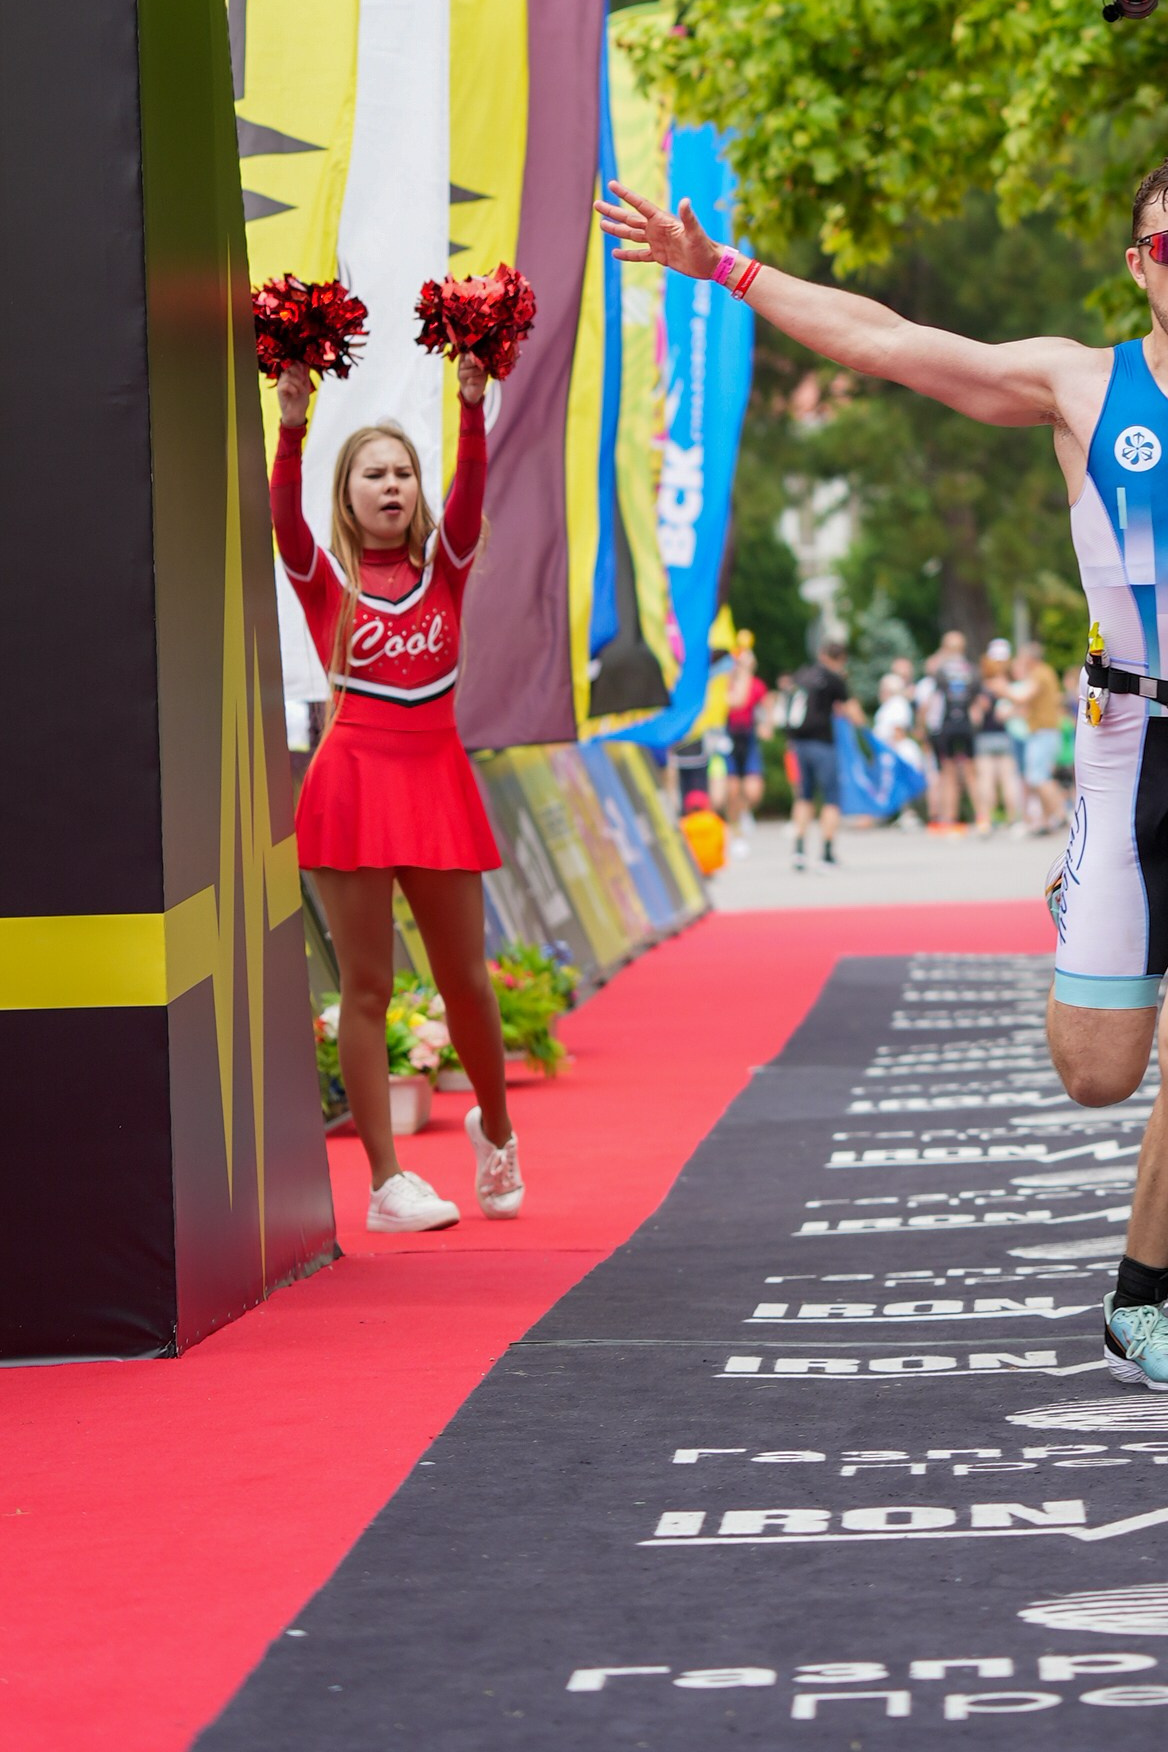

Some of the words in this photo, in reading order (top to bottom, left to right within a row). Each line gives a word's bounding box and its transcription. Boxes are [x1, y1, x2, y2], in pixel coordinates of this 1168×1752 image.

[347, 614, 443, 667] Cool
[799, 1210, 1055, 1232] IRON
[752, 1296, 1055, 1318] IRON
[724, 1350, 1058, 1374] IRON
[654, 1498, 1087, 1537] IRON
